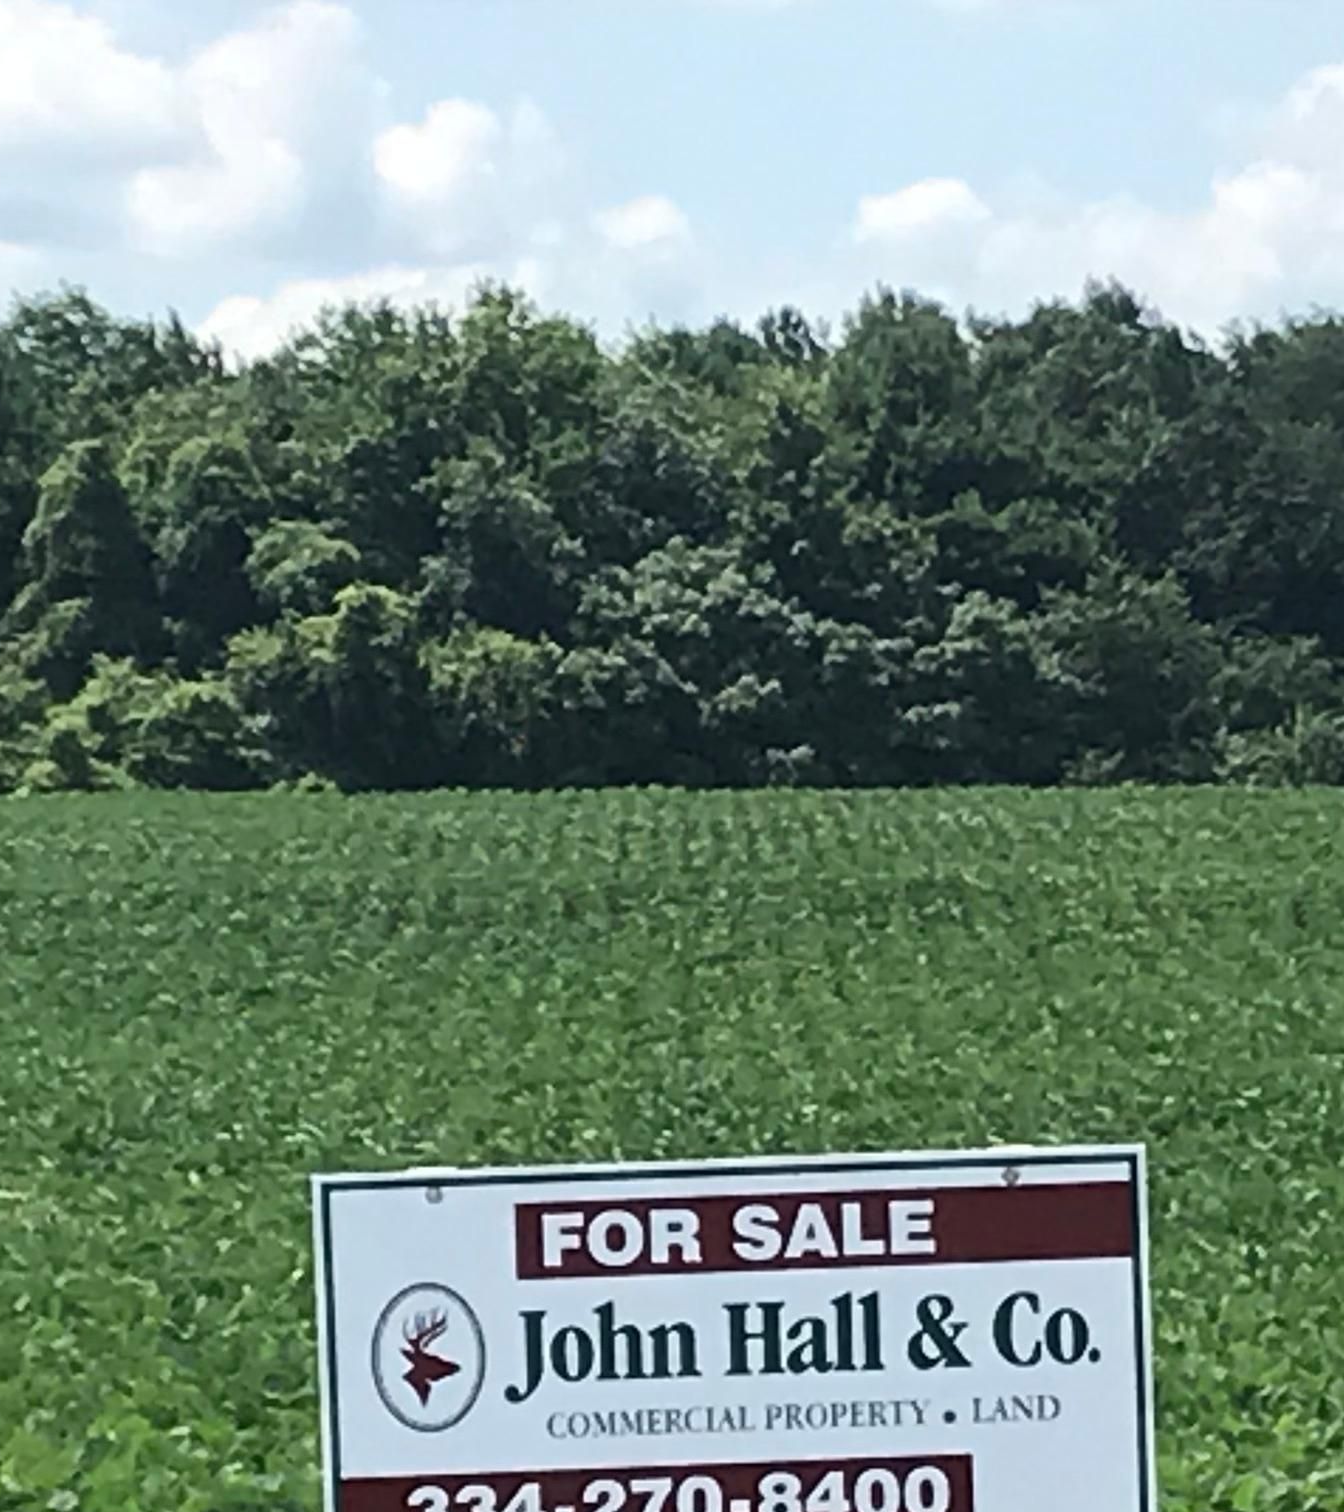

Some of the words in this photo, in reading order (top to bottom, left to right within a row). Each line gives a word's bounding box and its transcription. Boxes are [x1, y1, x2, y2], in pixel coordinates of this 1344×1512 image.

[540, 1210, 702, 1268] FOR
[732, 1199, 937, 1262] SALE
[503, 1299, 701, 1402] John
[723, 1291, 885, 1379] Hall
[906, 1293, 974, 1370] &
[992, 1290, 1102, 1366] Co.
[546, 1404, 755, 1439] COMMERCIAL
[765, 1399, 930, 1432] PROPERTY
[972, 1395, 1061, 1424] LAND
